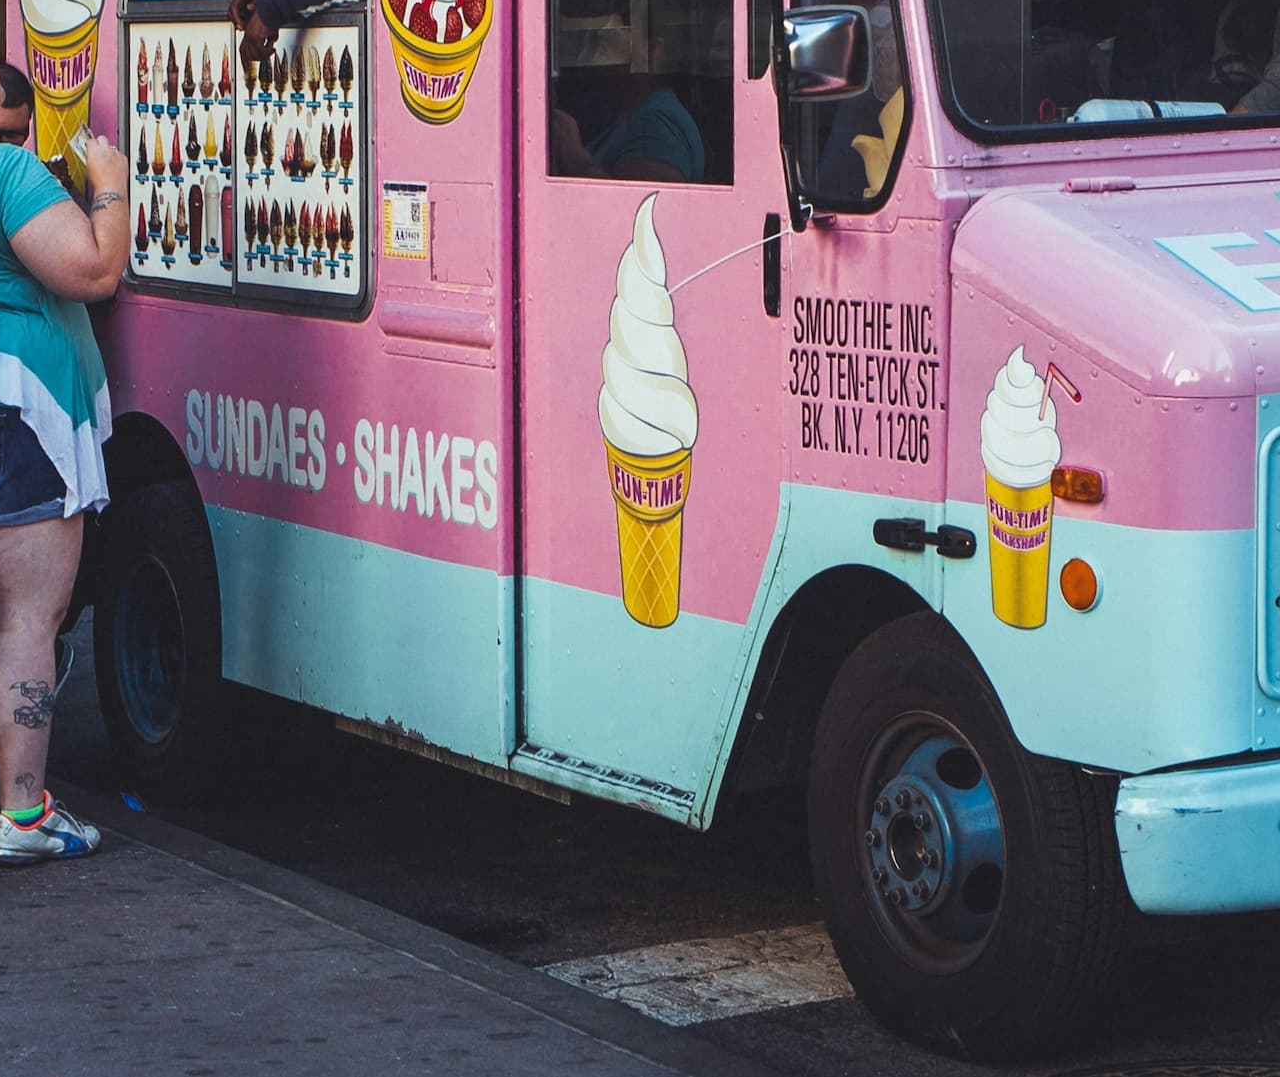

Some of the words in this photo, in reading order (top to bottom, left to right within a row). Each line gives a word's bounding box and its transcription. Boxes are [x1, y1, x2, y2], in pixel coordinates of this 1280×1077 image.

[33, 44, 91, 91] FUN-TIME
[402, 59, 465, 100] FUN-TIME
[793, 296, 893, 351] SMOOTHIE
[900, 303, 938, 355] INC.
[789, 348, 820, 398] 328
[916, 359, 946, 411] ST.
[801, 401, 829, 451] BK.
[834, 405, 868, 456] N.Y.
[875, 409, 930, 464] 11206
[185, 389, 327, 492] SUNDAES
[353, 418, 498, 531] SHAKES
[614, 464, 683, 508] FUN-TIME
[989, 498, 1049, 529] FUN-TIME
[992, 524, 1046, 550] MILKSHAKE
